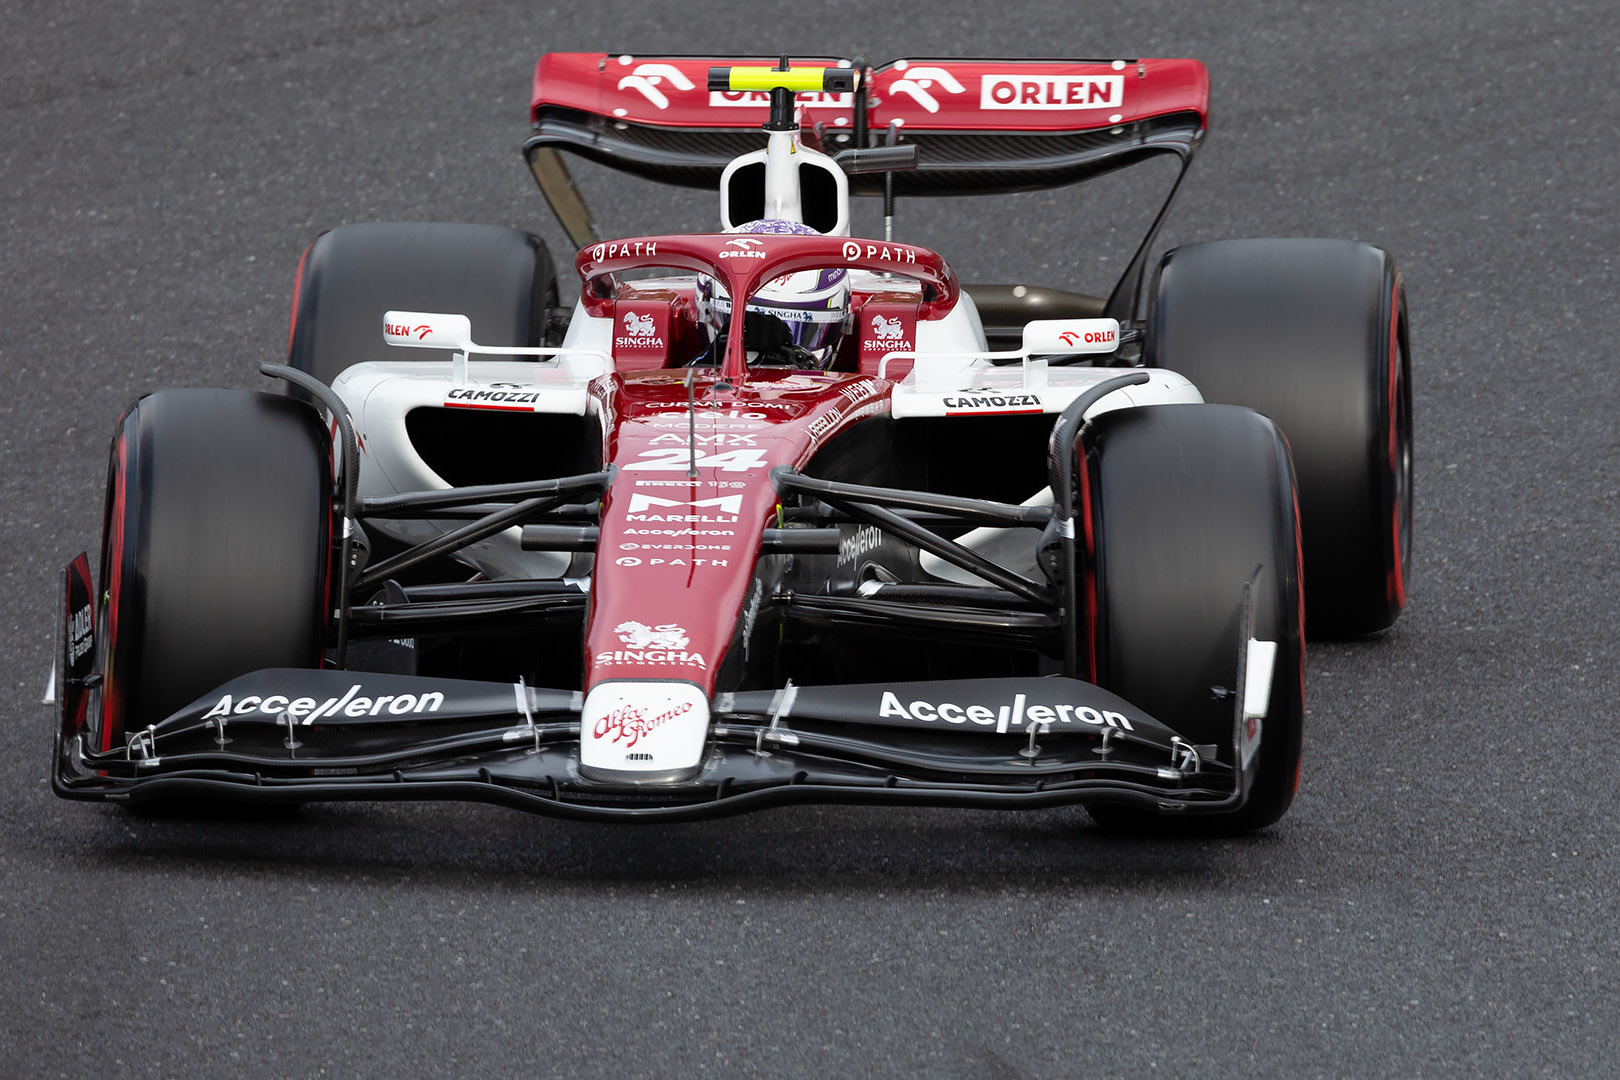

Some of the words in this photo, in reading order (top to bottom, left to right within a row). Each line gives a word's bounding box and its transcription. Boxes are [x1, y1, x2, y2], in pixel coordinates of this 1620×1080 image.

[991, 80, 1113, 105] ORLEN
[609, 242, 657, 258] PATH
[718, 250, 766, 260] ORLEN
[866, 245, 916, 264] PATH
[768, 309, 802, 319] SINGHA
[615, 337, 663, 346] SINGHA
[1084, 330, 1116, 344] ORLEN
[863, 340, 912, 349] SINGHA
[447, 388, 541, 403] CAMOZZI
[942, 394, 1041, 408] CAMOZZI
[731, 402, 791, 410] DOMI
[657, 410, 767, 420] cielo
[649, 433, 759, 444] AMX
[620, 448, 769, 473] 24
[625, 514, 739, 523] MARELLI
[623, 528, 735, 537] Accelleron
[649, 558, 729, 567] PATH
[596, 651, 706, 666] SINGHA
[201, 684, 445, 726] Accelleron
[878, 691, 1135, 734] Accelleron
[593, 704, 648, 744] Alfa
[621, 702, 693, 748] Romeo
